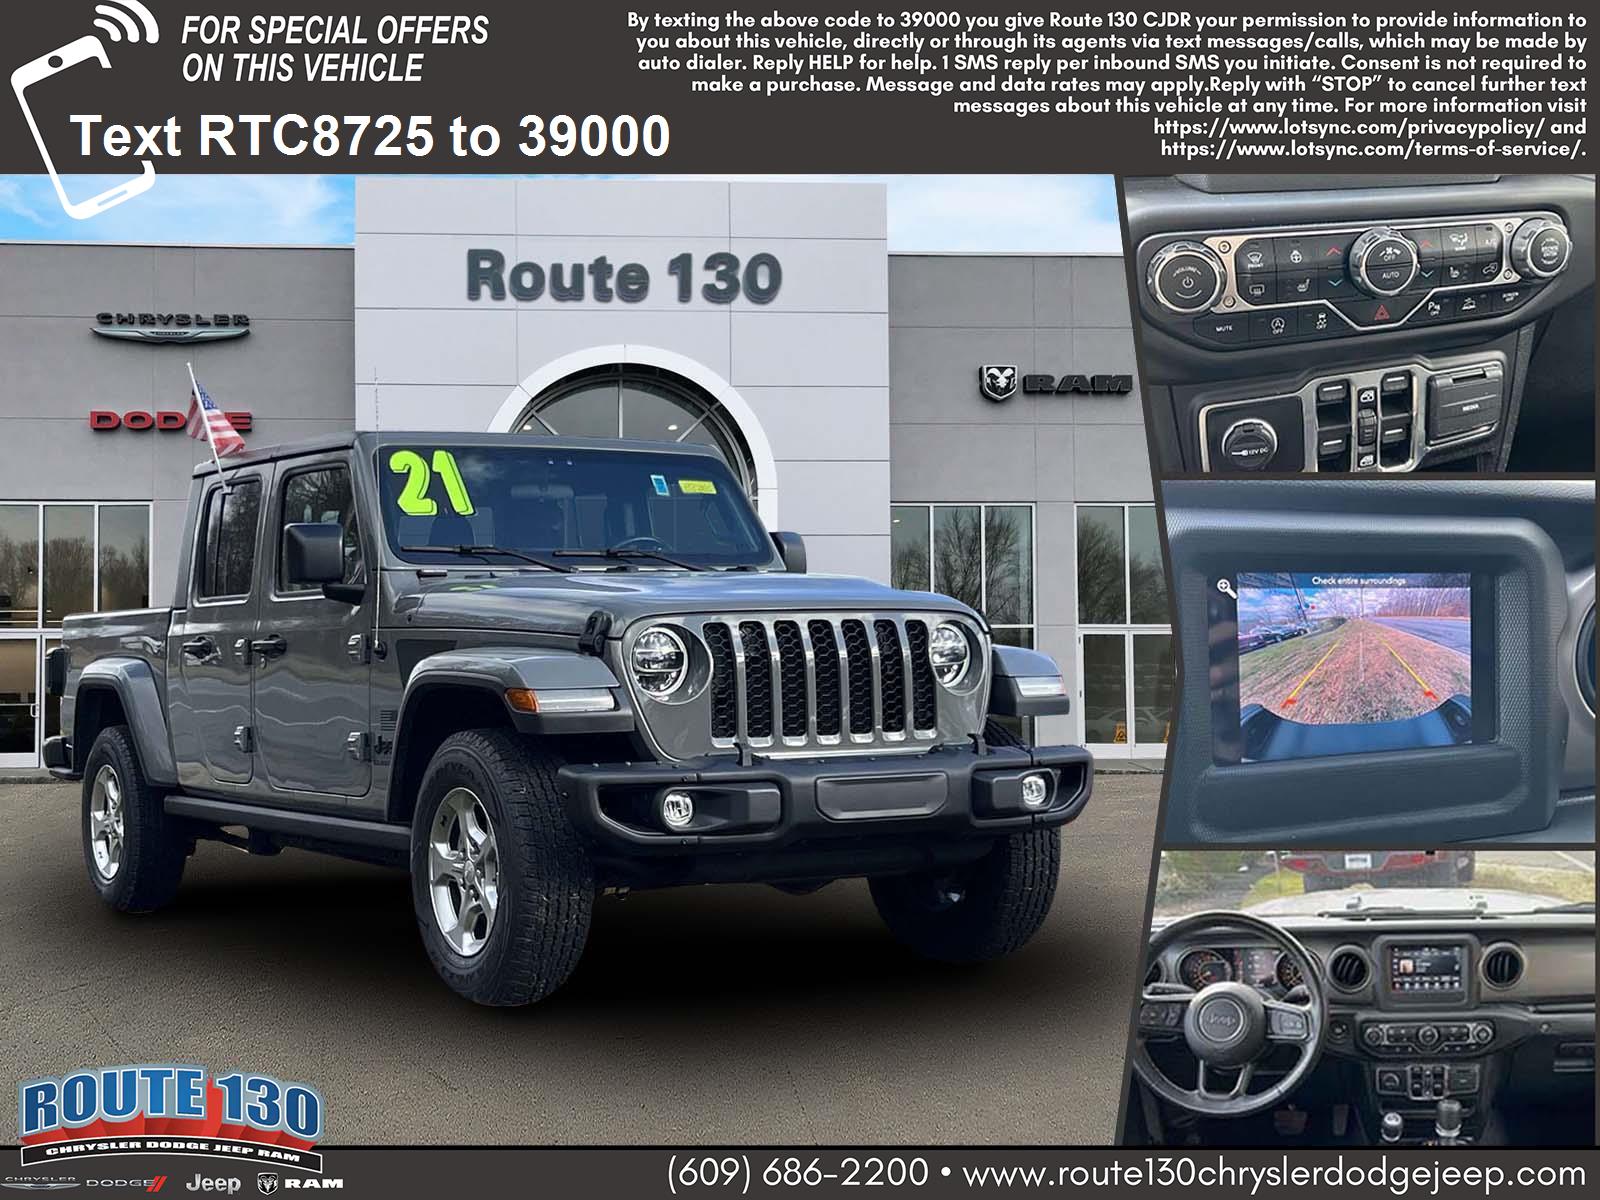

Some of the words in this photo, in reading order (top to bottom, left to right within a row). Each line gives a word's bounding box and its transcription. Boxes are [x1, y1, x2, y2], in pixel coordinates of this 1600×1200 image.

[467, 249, 650, 303] Route
[668, 251, 782, 305] 130
[96, 312, 250, 327] CHRYSLER
[1023, 374, 1133, 393] RAM
[90, 410, 252, 432] DODE
[389, 450, 475, 515] 21
[1312, 576, 1336, 585] Check
[1338, 576, 1358, 585] entire
[1360, 576, 1407, 586] surroundings
